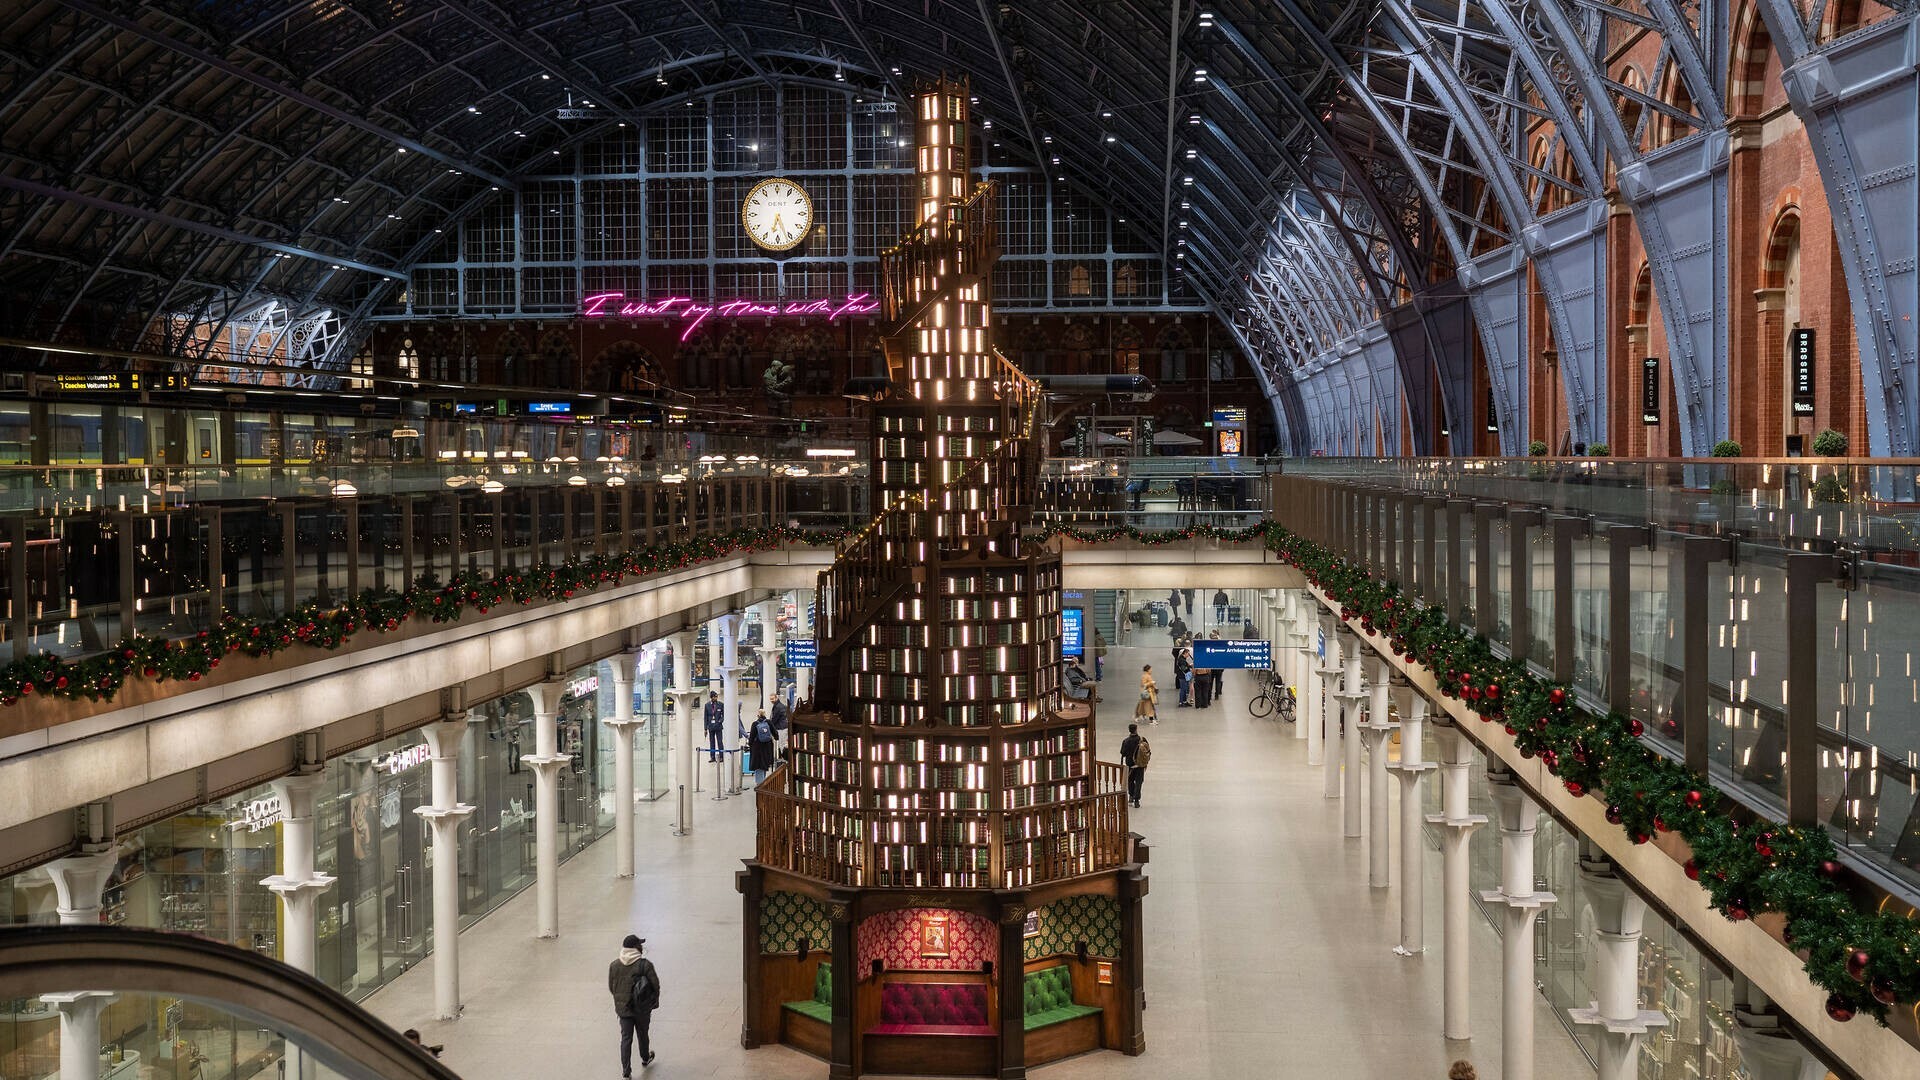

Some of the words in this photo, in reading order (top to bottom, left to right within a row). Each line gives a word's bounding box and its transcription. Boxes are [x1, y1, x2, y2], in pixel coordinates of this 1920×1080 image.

[585, 293, 623, 315] I
[622, 297, 690, 314] want
[682, 304, 713, 341] my
[718, 300, 778, 315] time
[786, 299, 831, 314] with
[1800, 333, 1808, 391] BRASSERIE
[168, 376, 174, 386] 5
[575, 676, 598, 698] CHANEL
[390, 743, 431, 775] CHANEL
